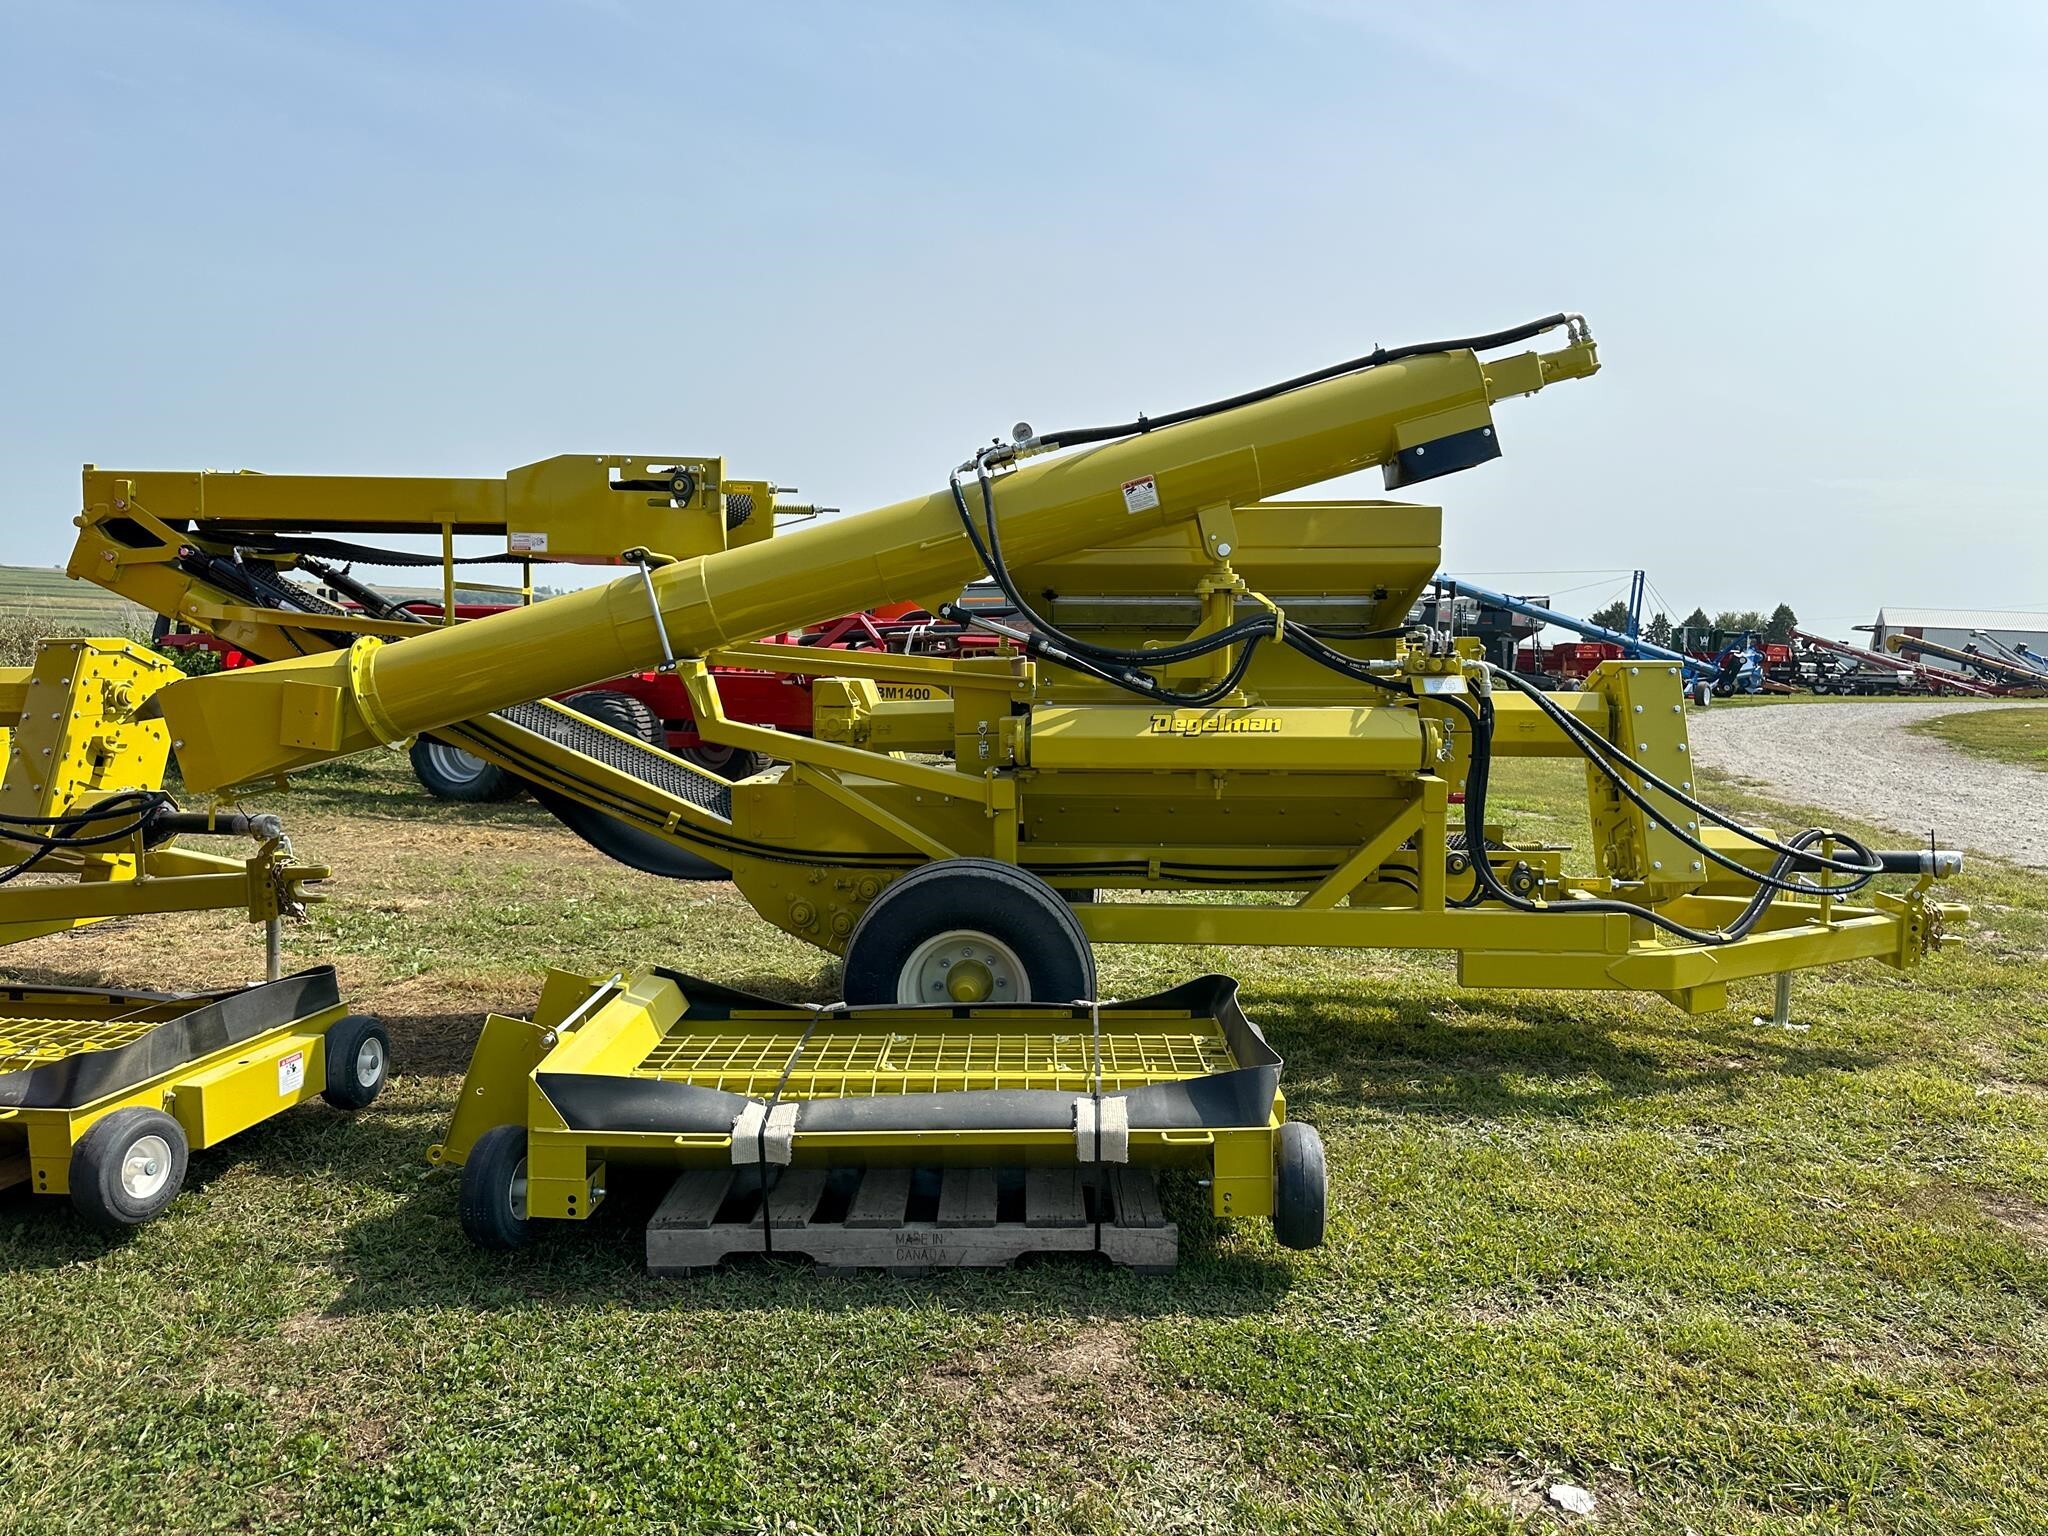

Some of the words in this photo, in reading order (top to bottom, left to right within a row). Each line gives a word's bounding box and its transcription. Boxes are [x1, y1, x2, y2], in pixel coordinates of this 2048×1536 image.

[1151, 713, 1282, 737] Degelman
[932, 1233, 943, 1245] IN
[896, 1248, 946, 1261] CANADA
